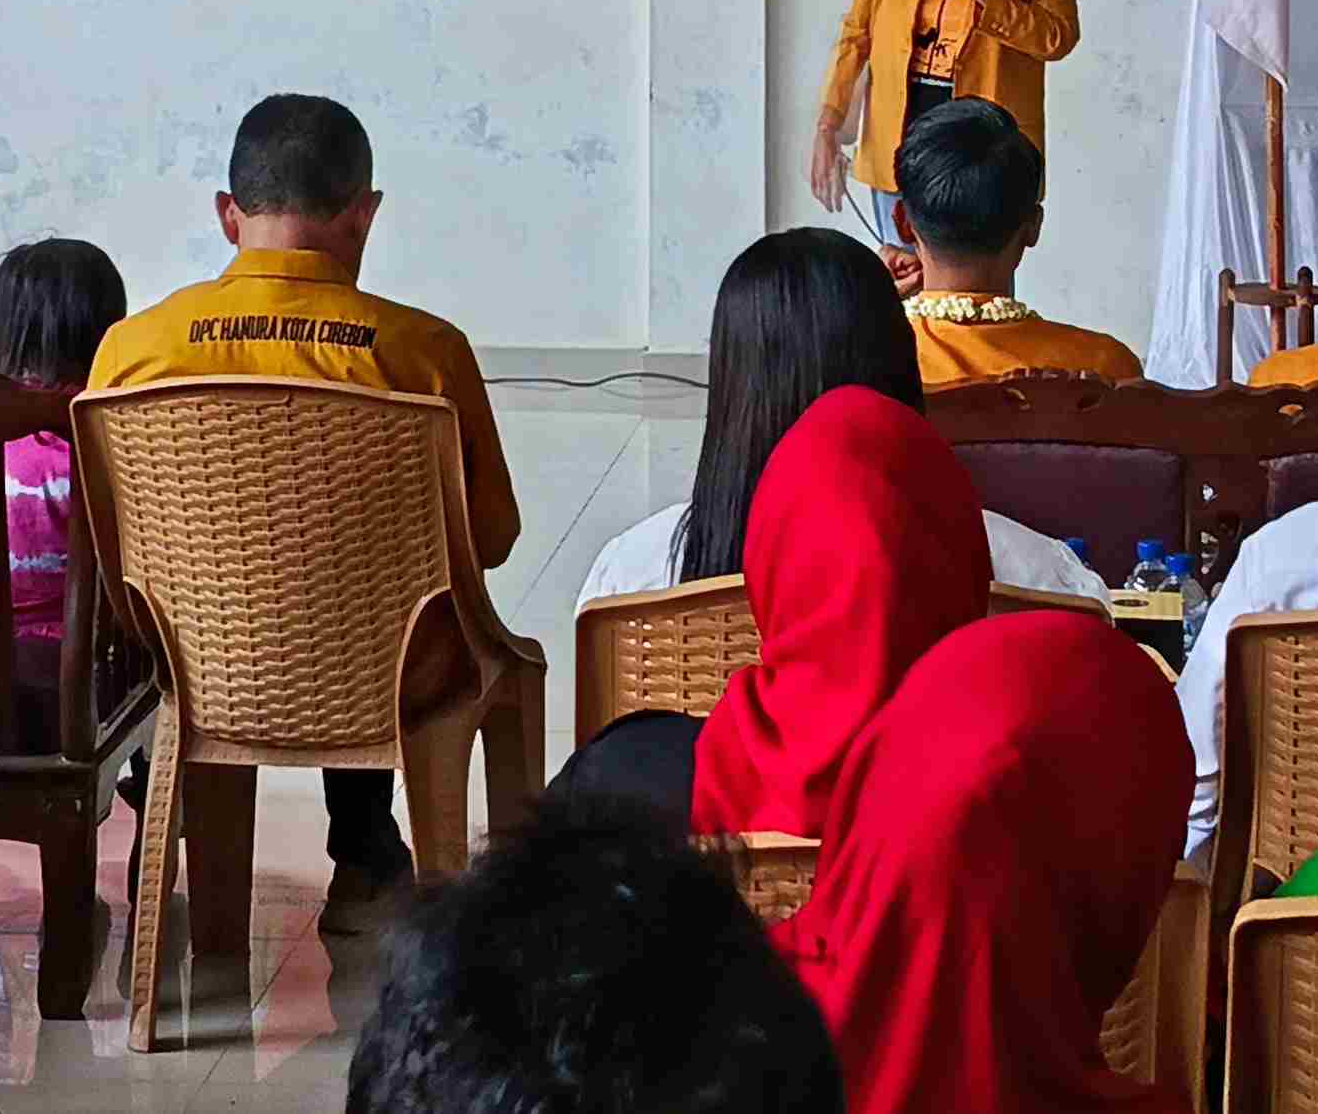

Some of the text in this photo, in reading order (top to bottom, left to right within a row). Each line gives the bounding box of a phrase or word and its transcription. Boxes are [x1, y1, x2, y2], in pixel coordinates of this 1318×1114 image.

[188, 315, 379, 349] DPC HANURA KOTA CIREBON
